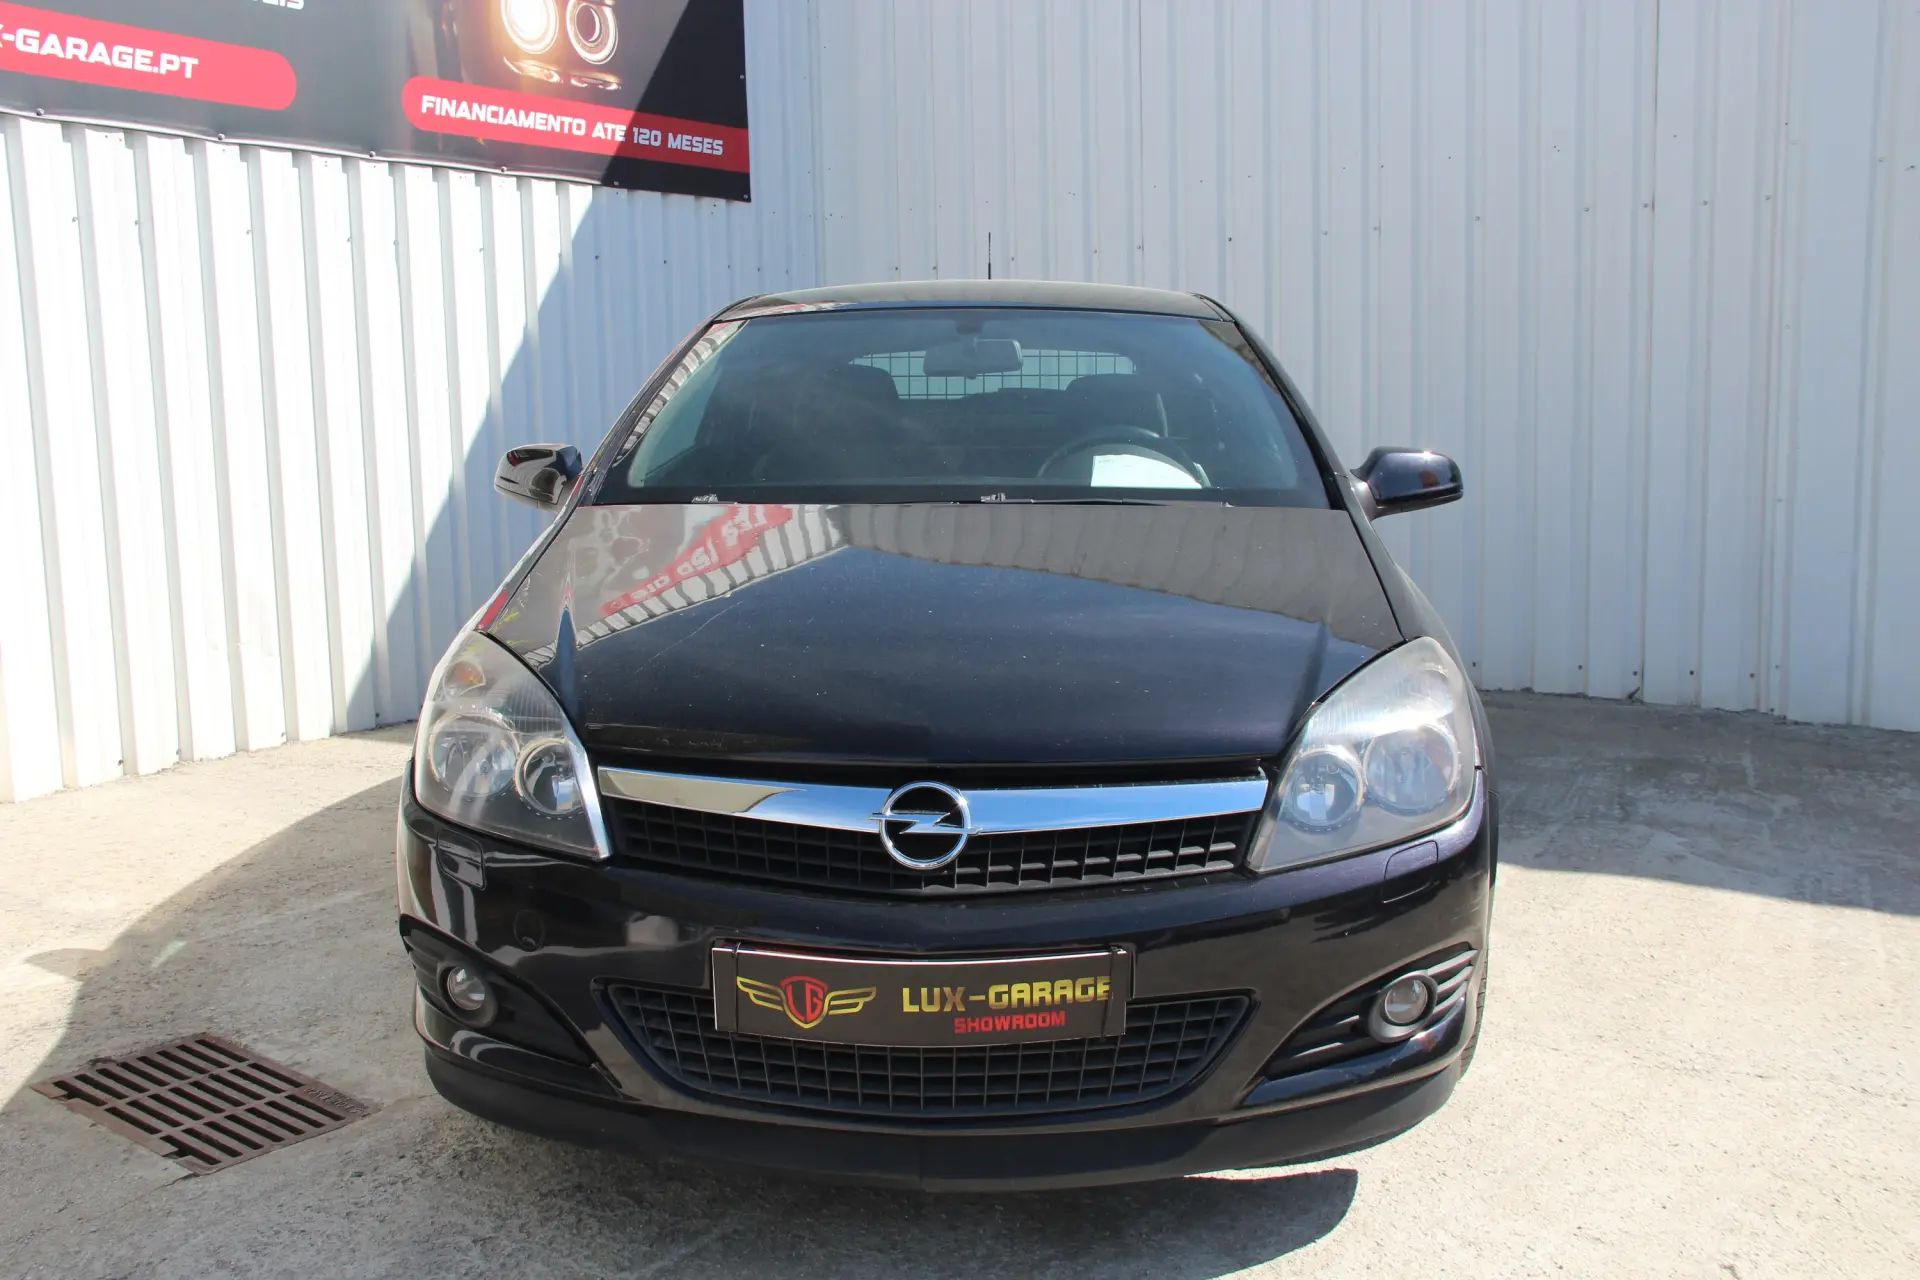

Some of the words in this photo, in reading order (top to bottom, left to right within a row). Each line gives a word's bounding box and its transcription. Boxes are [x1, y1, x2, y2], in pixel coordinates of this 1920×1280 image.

[0, 24, 199, 78] -GARAGE.PT
[421, 95, 586, 136] FINANCIAMENTO
[592, 121, 626, 142] ATE
[632, 126, 662, 147] 120
[667, 132, 724, 156] MESES
[902, 976, 1111, 1013] LUX-GARAGE
[954, 1011, 1066, 1034] SHOWROOM
